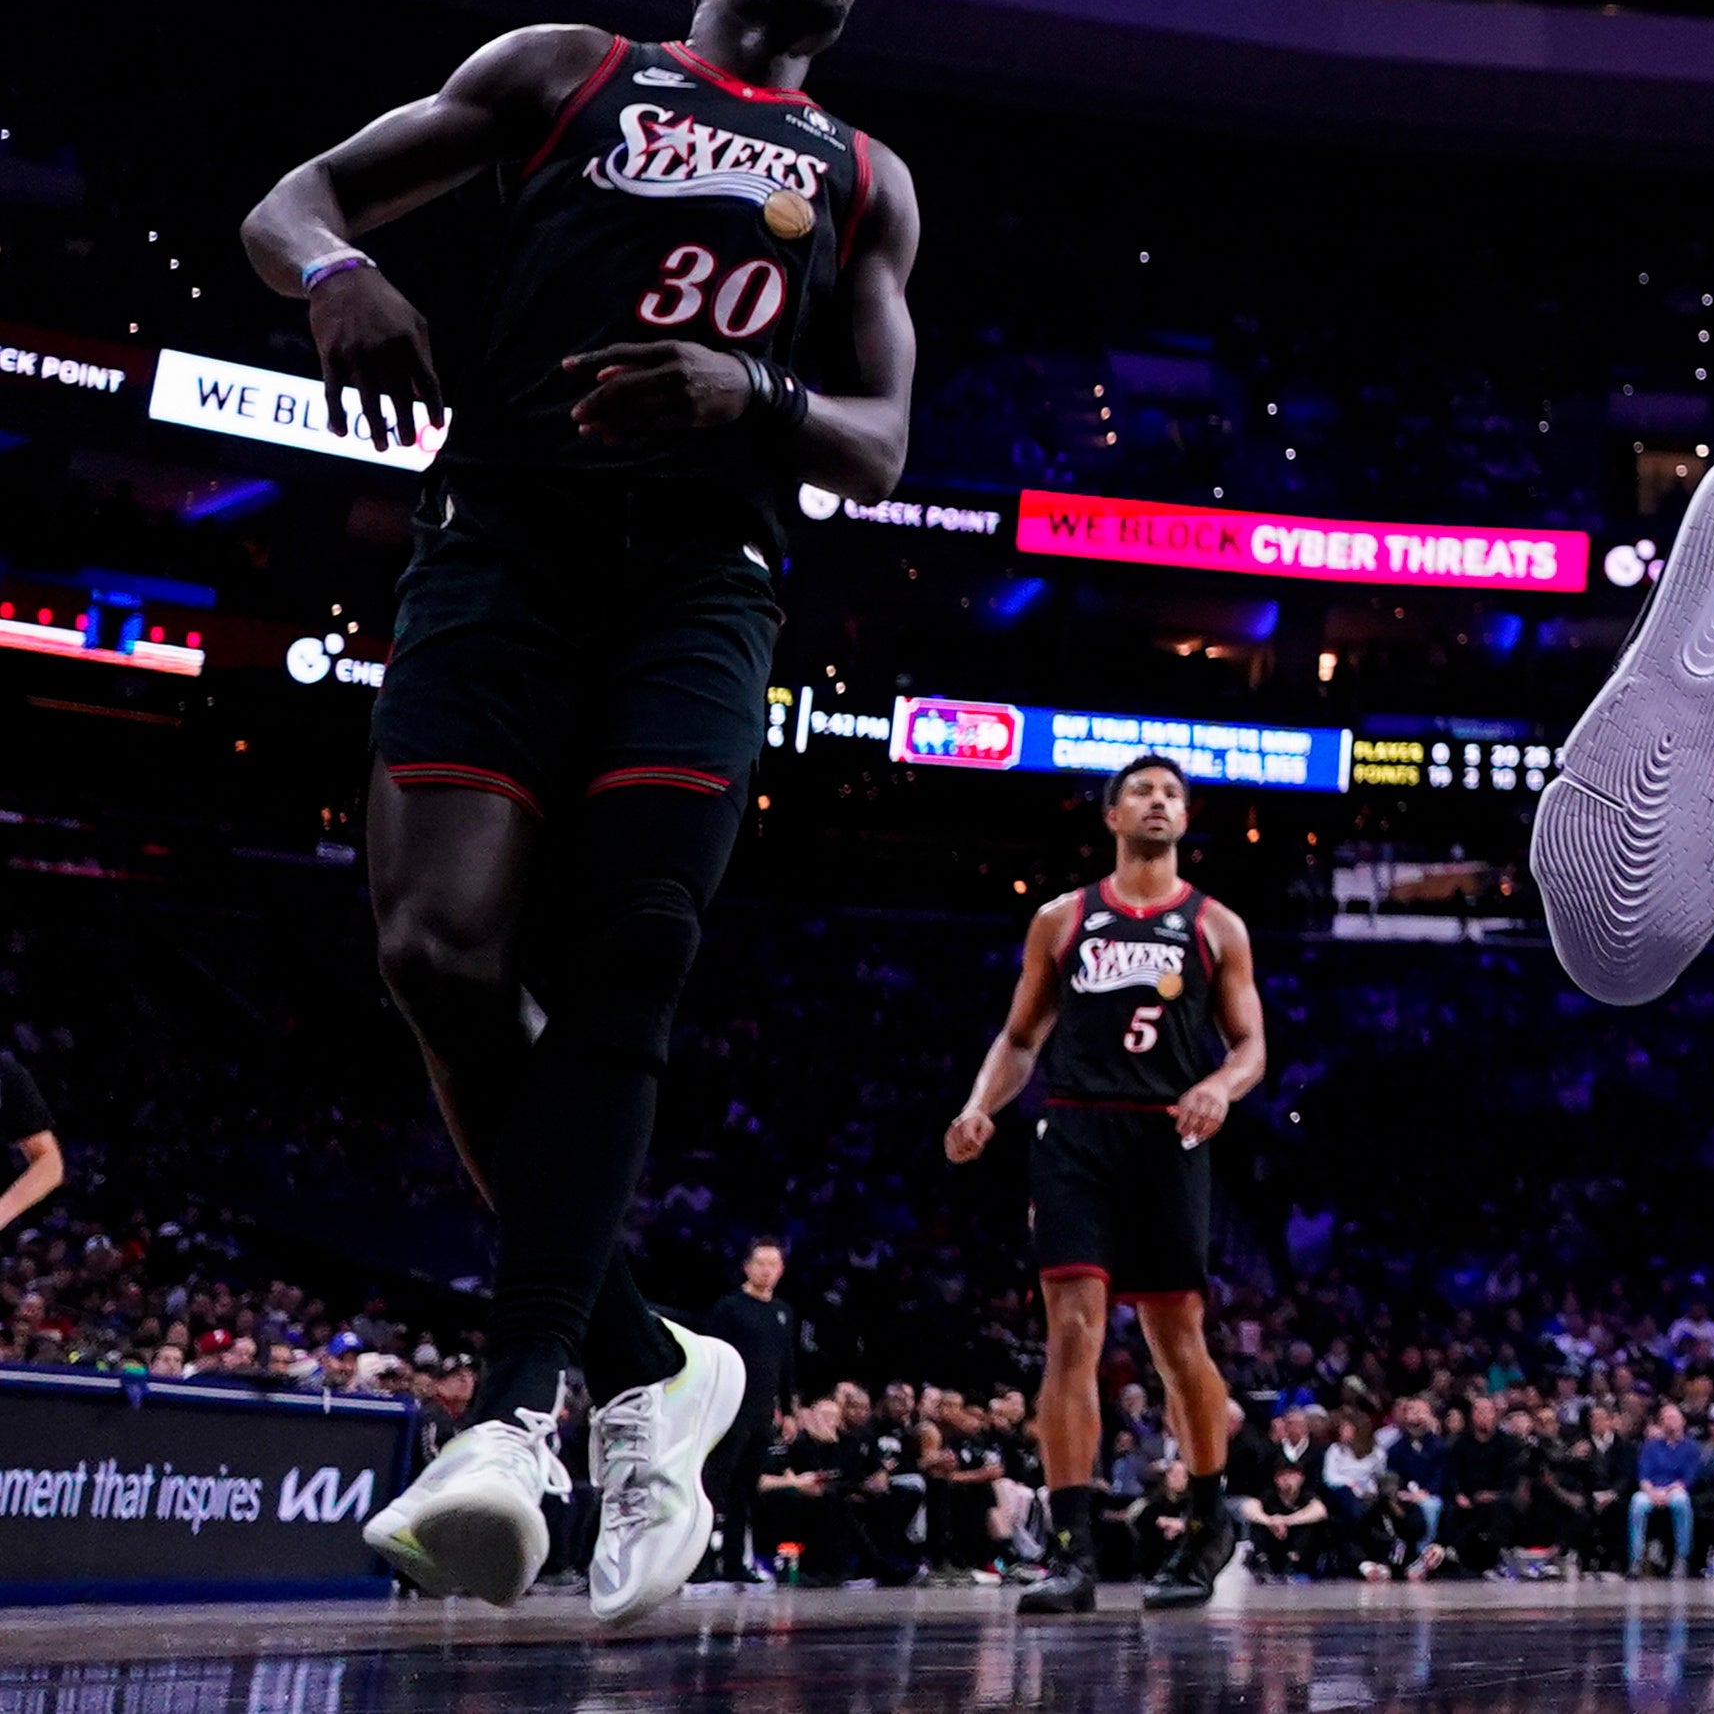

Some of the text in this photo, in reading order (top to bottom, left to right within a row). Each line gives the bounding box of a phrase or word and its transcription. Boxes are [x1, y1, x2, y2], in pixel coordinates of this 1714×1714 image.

[582, 102, 829, 199] SIXERS
[637, 243, 788, 338] 30
[0, 347, 126, 393] CK POINT
[198, 376, 260, 417] WE
[273, 393, 402, 447] BLCK
[926, 505, 1000, 535] POINT
[1048, 510, 1557, 580] WE BLOCK CYBER THREATS
[335, 657, 386, 688] CHE
[1124, 1005, 1164, 1054] 5
[0, 1460, 86, 1518] ment
[91, 1457, 154, 1519] that
[156, 1462, 262, 1536] inspires
